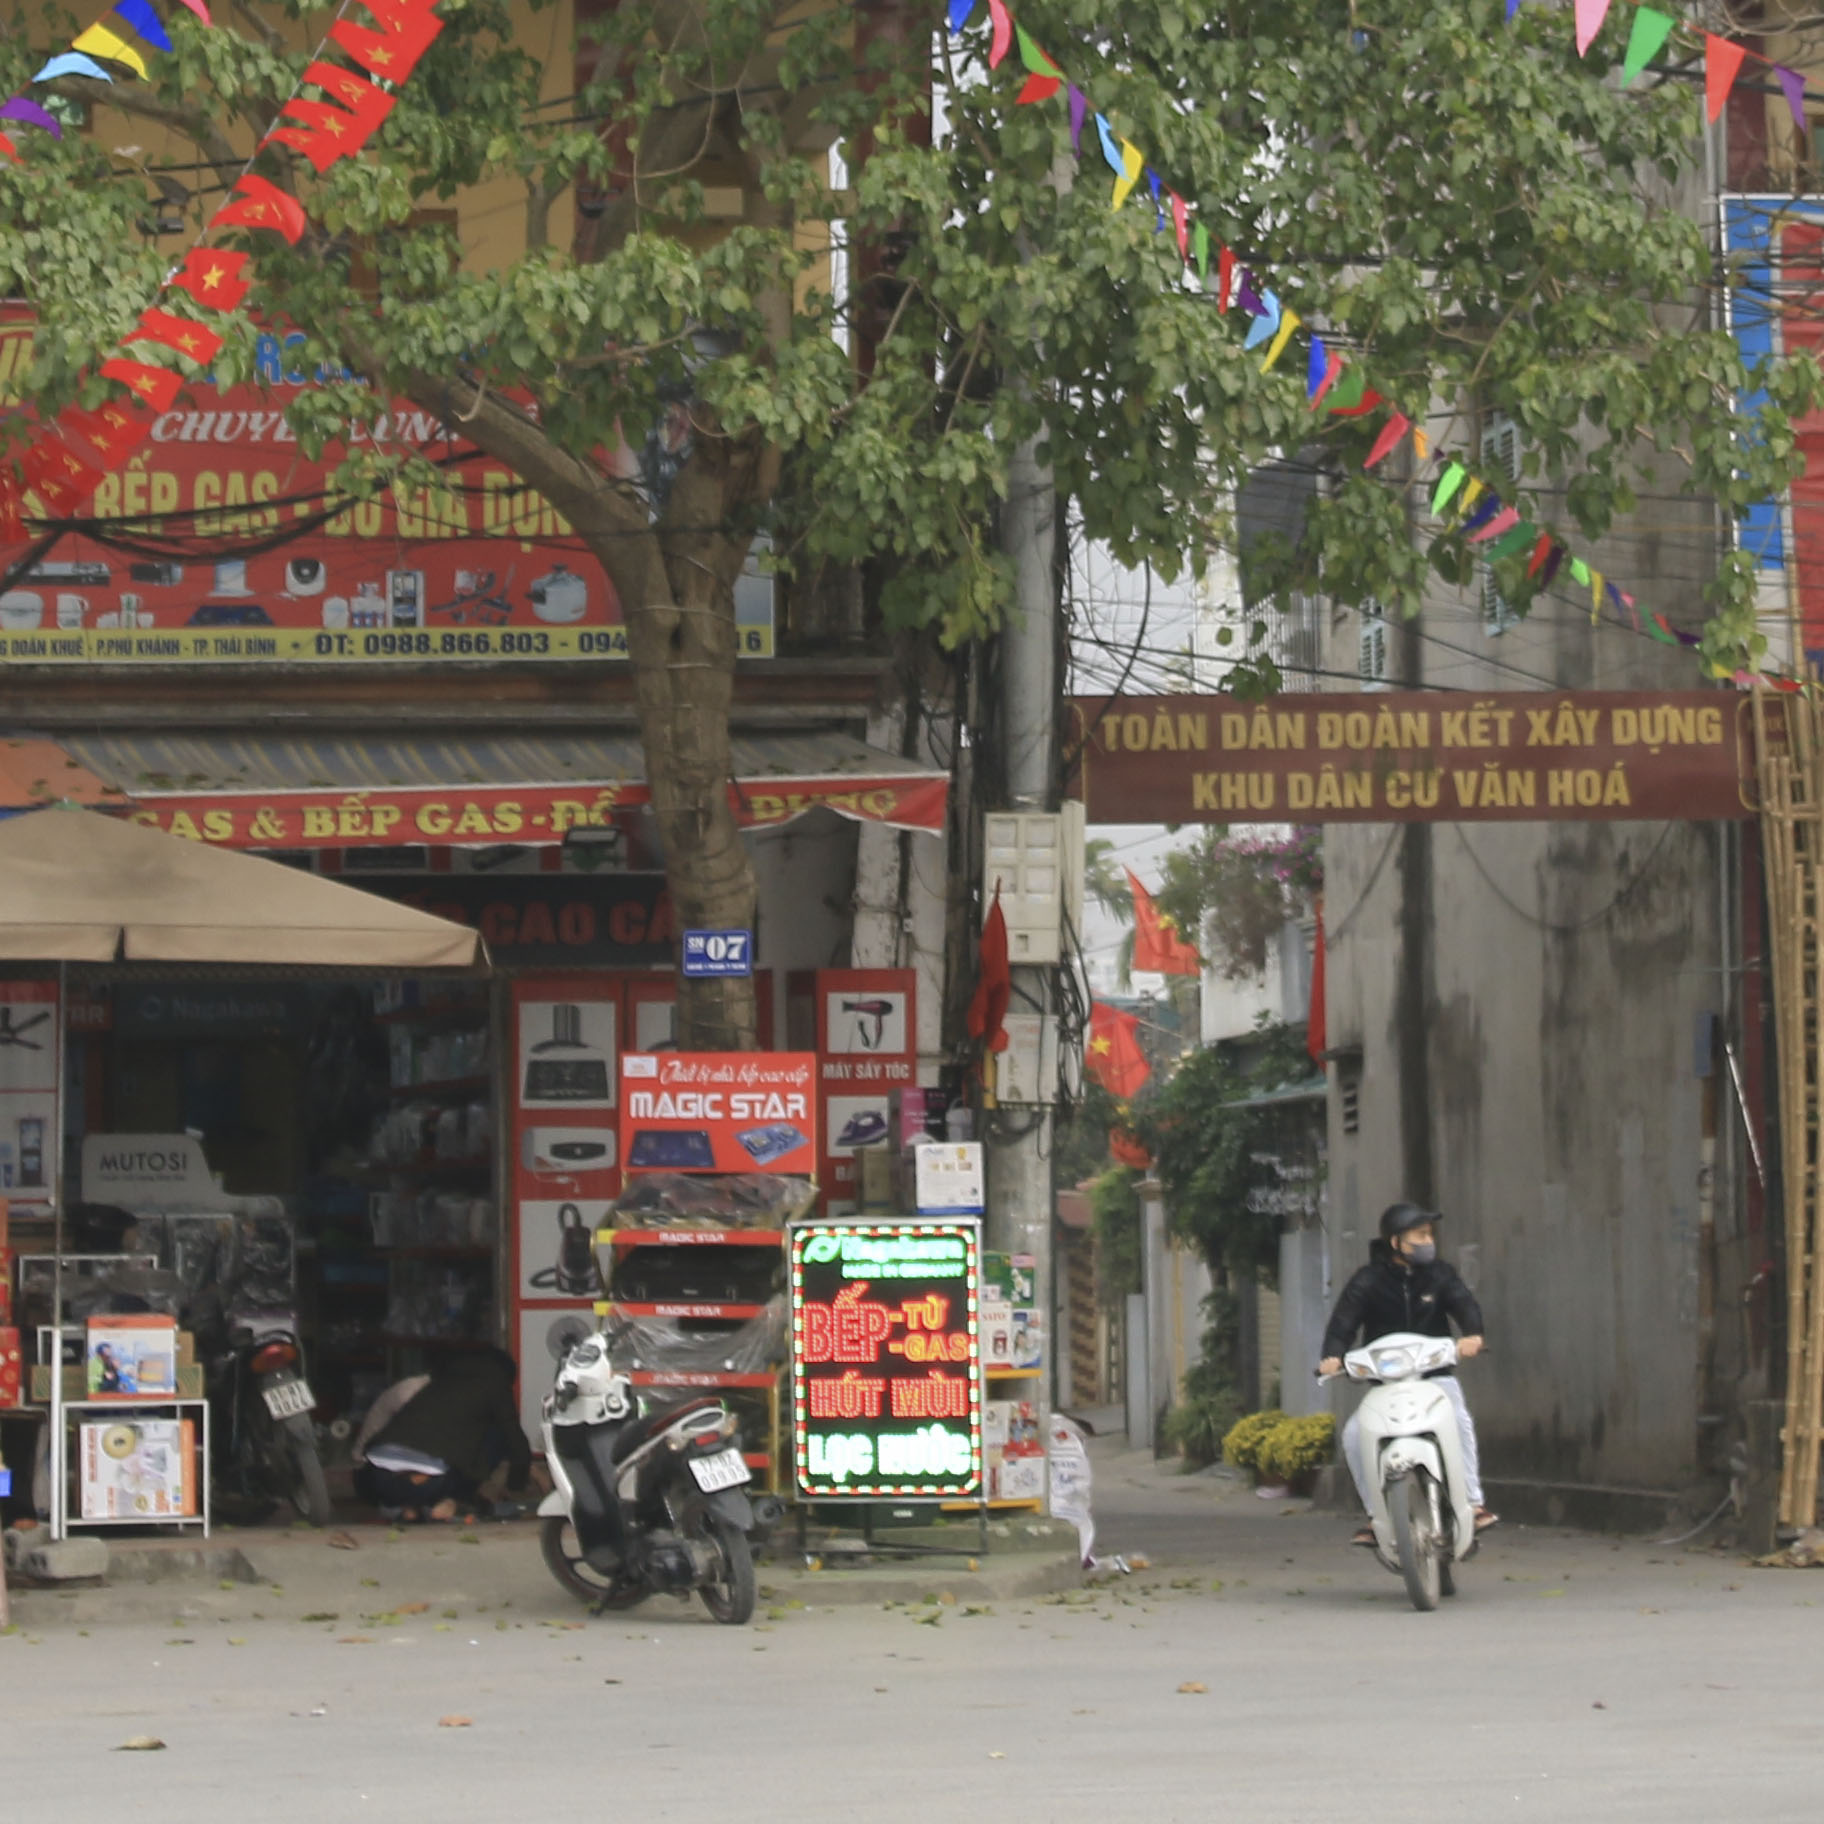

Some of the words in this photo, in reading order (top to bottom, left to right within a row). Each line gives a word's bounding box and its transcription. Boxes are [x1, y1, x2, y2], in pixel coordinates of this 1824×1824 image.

[192, 470, 280, 539] GAS
[314, 632, 355, 656] ĐT:
[363, 631, 551, 656] 0988.866.803
[1100, 704, 1208, 753] TOÀN
[1219, 703, 1307, 752] DÂN
[1316, 702, 1431, 751] ĐOÀN
[1441, 700, 1514, 750] KẾT
[1525, 698, 1601, 748] XÂY
[1611, 703, 1723, 756] DỰNG
[1192, 772, 1275, 811] KHU
[1286, 761, 1372, 810] DÂN
[1386, 768, 1441, 810] CƯ
[1454, 760, 1535, 809] VĂN
[1548, 759, 1632, 808] HOÁ
[249, 806, 287, 842] &
[302, 791, 402, 840] BẾP
[414, 801, 522, 837] GAS
[479, 899, 595, 945] CAO
[705, 934, 747, 961] 07
[822, 1061, 852, 1080] MÁY
[629, 1091, 726, 1120] MAGIC
[729, 1091, 808, 1120] STAR
[98, 1150, 188, 1173] MUTOSI
[802, 1280, 890, 1363] BẾP
[809, 1369, 886, 1418] HÚT
[890, 1369, 968, 1418] MÙI
[806, 1431, 874, 1483] LỌC
[876, 1421, 973, 1476] NƯỚC
